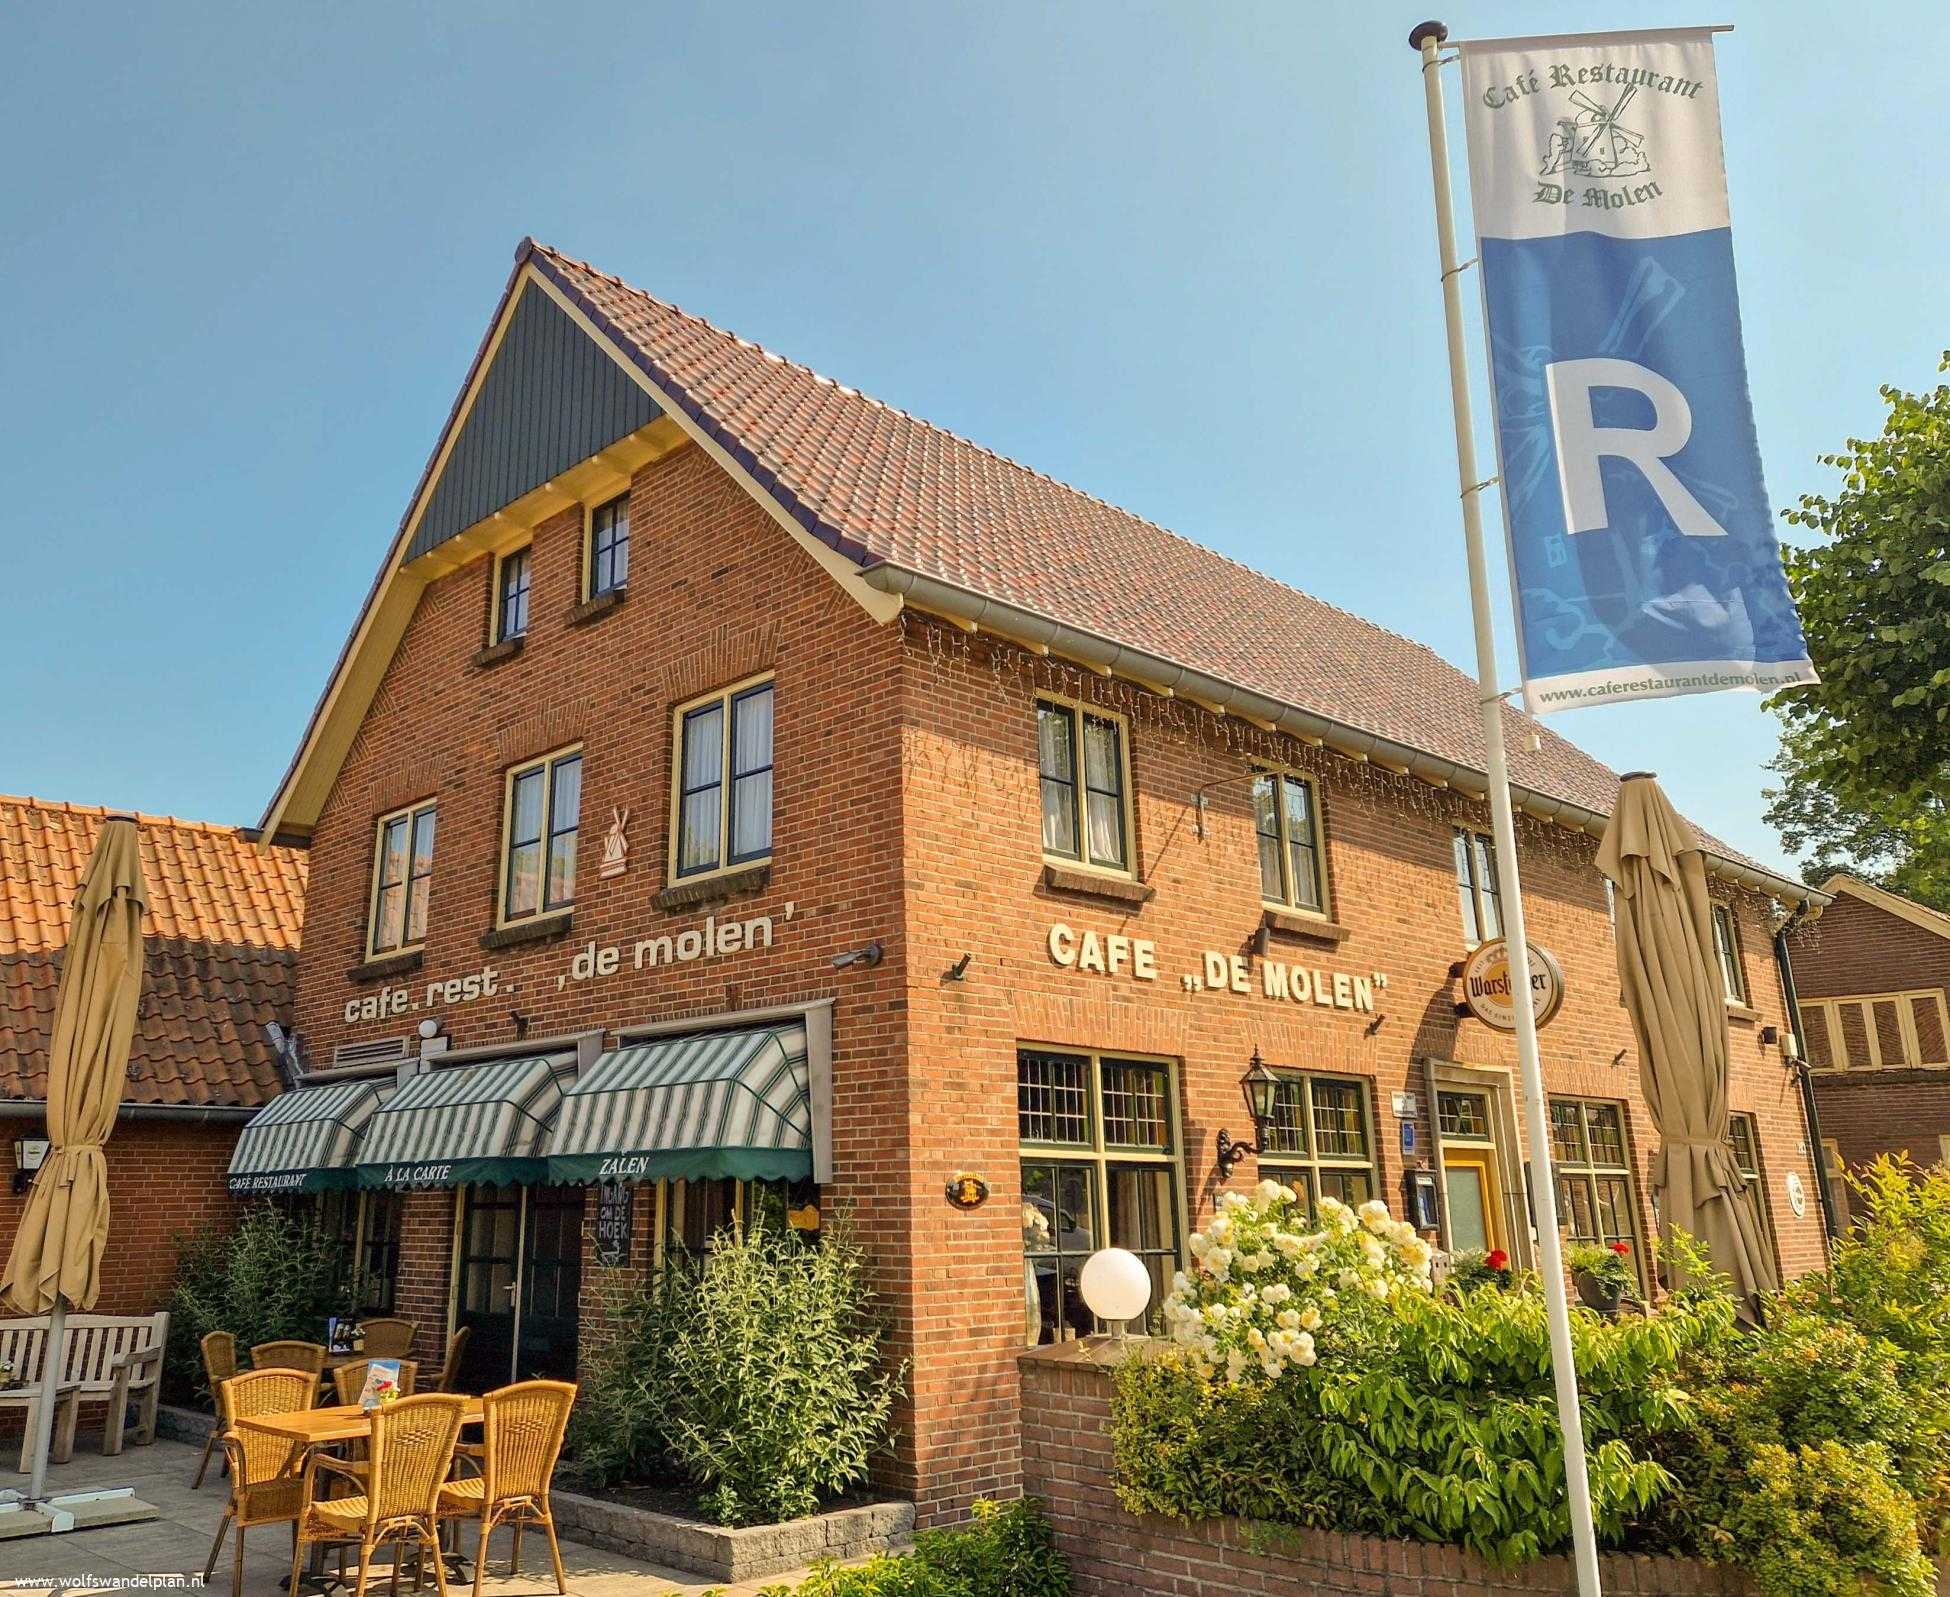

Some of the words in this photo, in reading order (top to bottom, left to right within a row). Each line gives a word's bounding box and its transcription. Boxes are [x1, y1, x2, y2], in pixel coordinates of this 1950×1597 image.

[1483, 69, 1541, 109] Café
[1549, 62, 1704, 100] Restaurant
[1532, 181, 1575, 205] De
[1583, 181, 1663, 210] Molen
[1545, 357, 1728, 536] R
[1539, 671, 1801, 704] www.caferestaurantdemolen.nl
[1048, 923, 1158, 980] CAFE
[1470, 971, 1546, 997] Warster
[396, 1167, 410, 1182] LA
[413, 1164, 451, 1181] CARTE
[599, 1157, 649, 1175] ZALEN
[229, 1174, 251, 1190] CAFÉ
[253, 1173, 306, 1189] RESTAURANT
[614, 1205, 627, 1221] DE
[599, 1221, 628, 1239] HOEK
